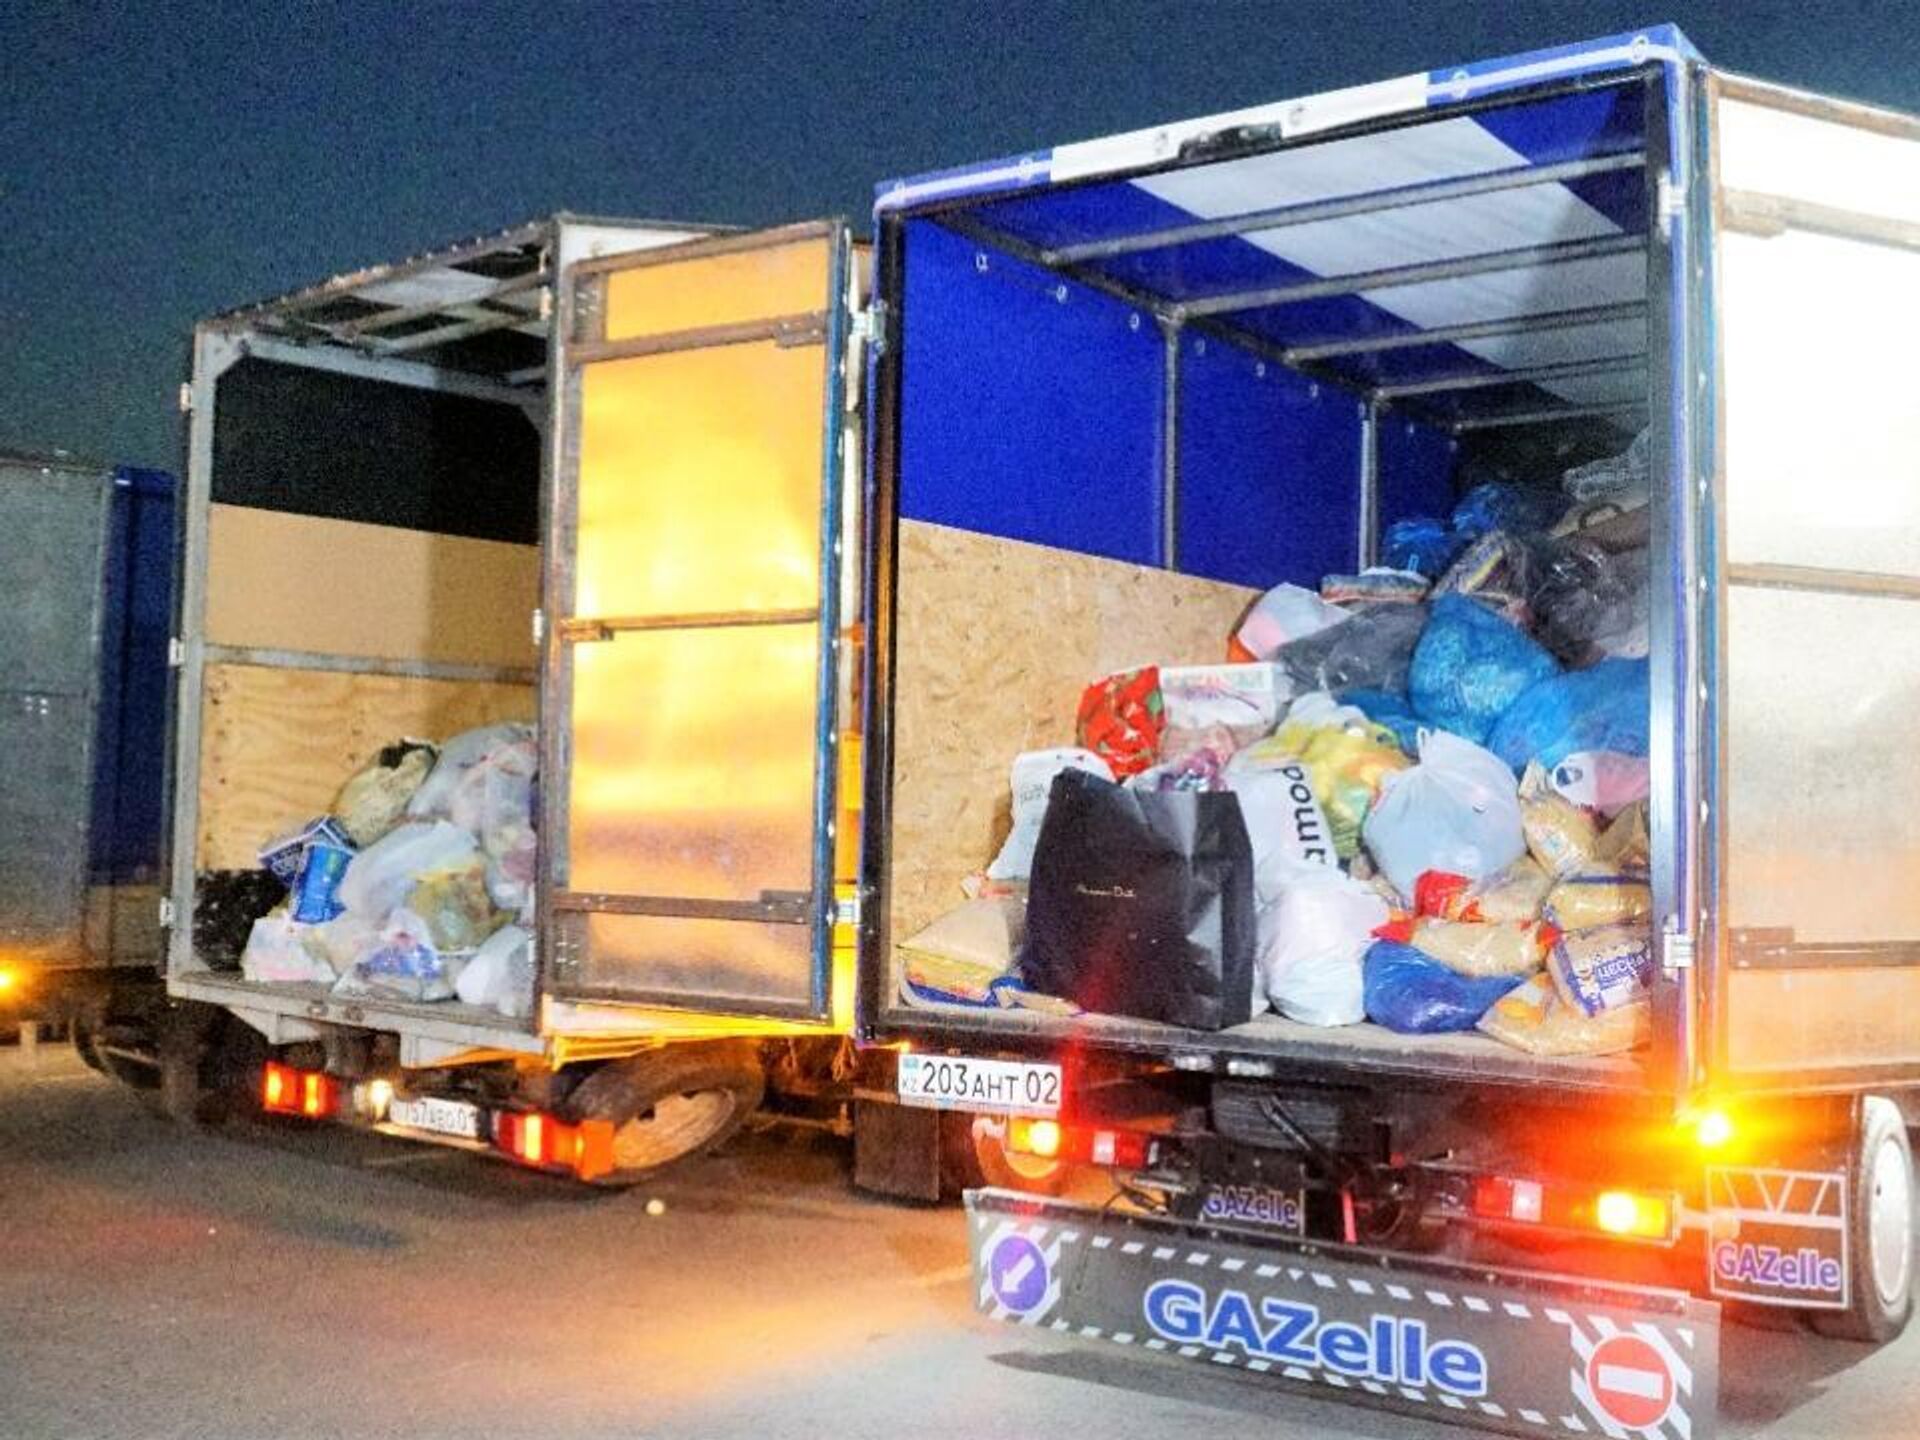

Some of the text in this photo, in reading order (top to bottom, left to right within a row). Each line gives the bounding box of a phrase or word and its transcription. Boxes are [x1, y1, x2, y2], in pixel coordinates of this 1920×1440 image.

[1026, 1069, 1058, 1105] 02
[1203, 1184, 1297, 1229] GAZelle
[1714, 1240, 1840, 1291] GAZelle
[1143, 1279, 1487, 1397] GAZelle
